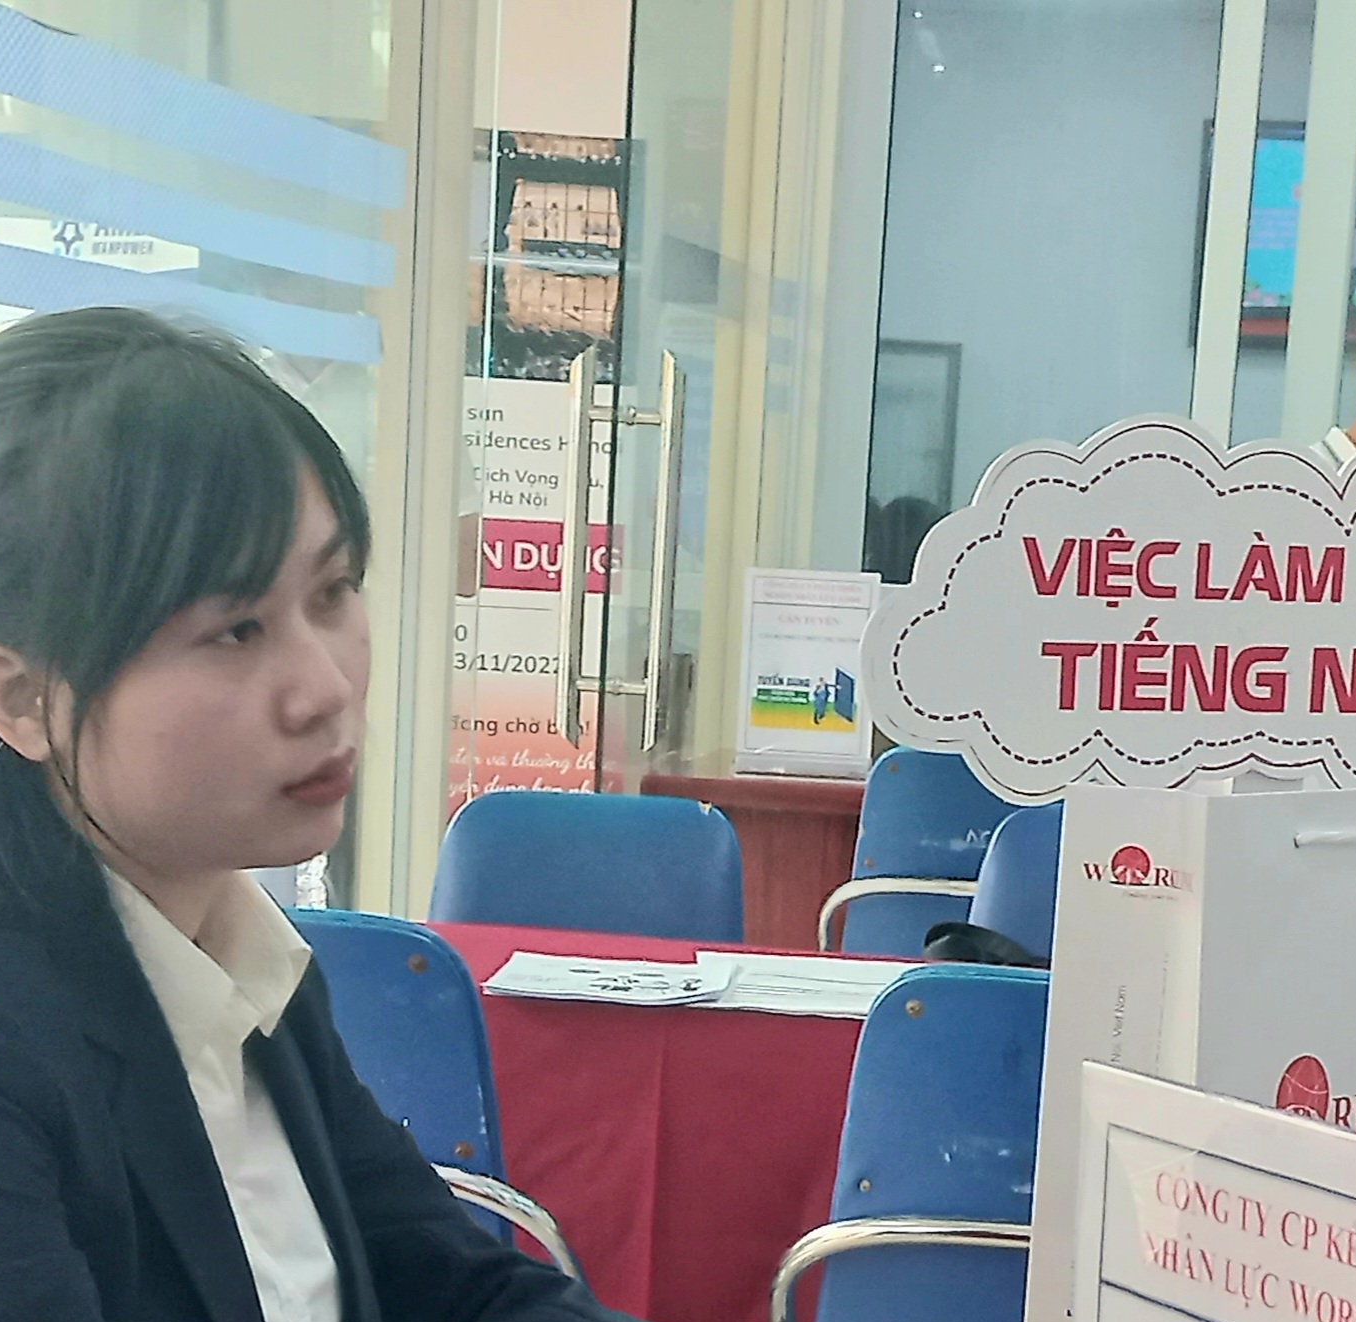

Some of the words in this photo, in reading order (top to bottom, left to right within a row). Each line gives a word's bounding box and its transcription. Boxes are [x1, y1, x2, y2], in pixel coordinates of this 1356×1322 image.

[1021, 527, 1182, 608] VIỆC
[1194, 531, 1346, 603] LÀM
[1041, 616, 1289, 714] TIẾNG
[1155, 1164, 1230, 1224] CÔNG
[1237, 1195, 1271, 1239] TY
[1280, 1210, 1319, 1252] CP
[1145, 1231, 1215, 1283] NHÂN
[1224, 1262, 1279, 1309] LỰC
